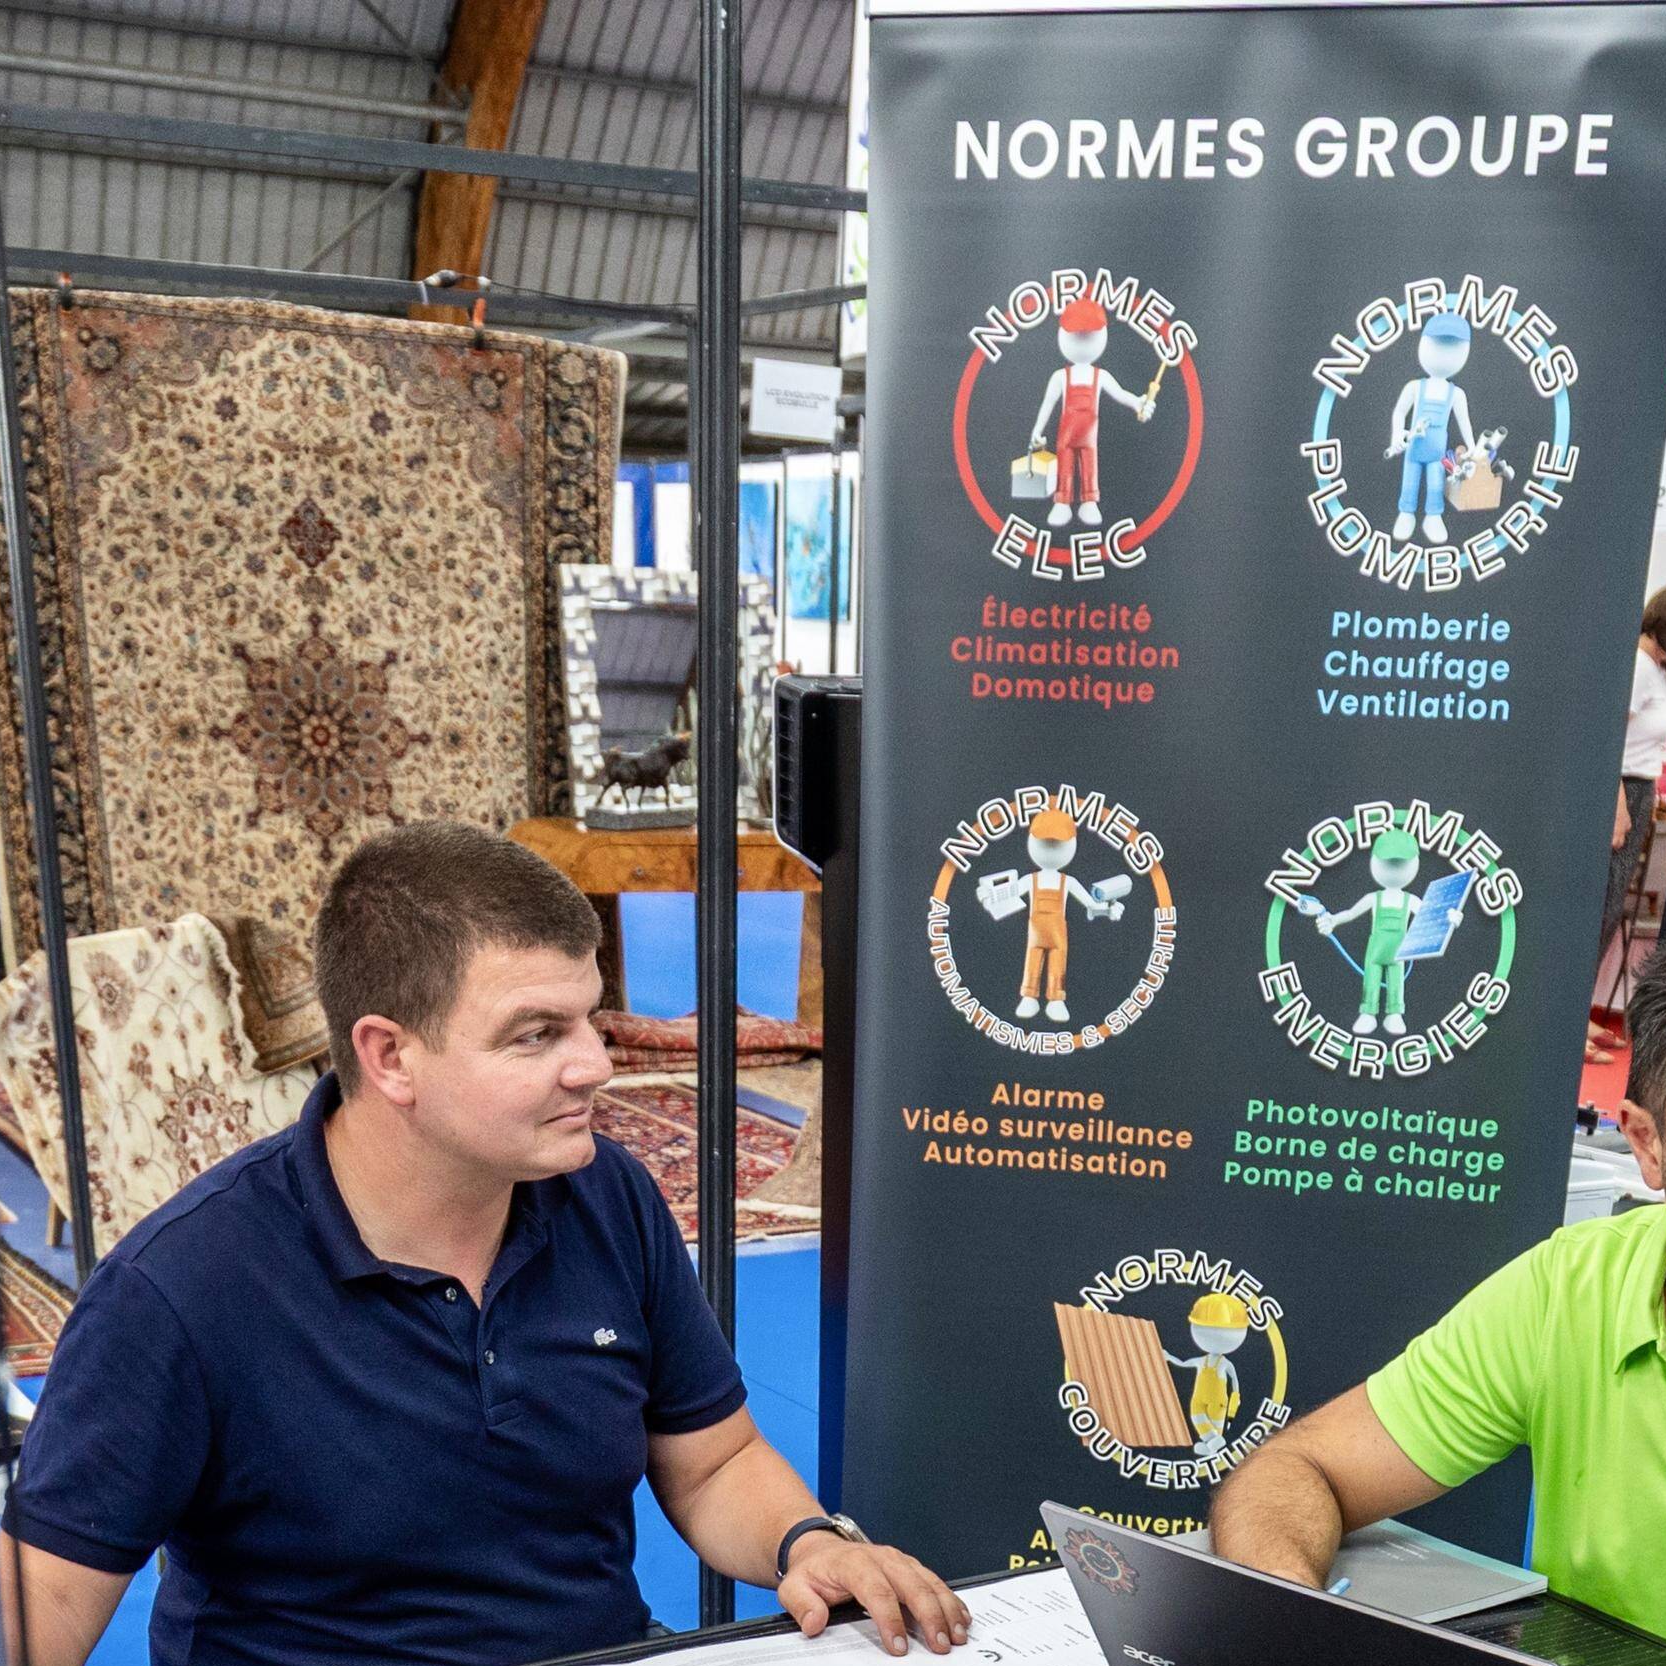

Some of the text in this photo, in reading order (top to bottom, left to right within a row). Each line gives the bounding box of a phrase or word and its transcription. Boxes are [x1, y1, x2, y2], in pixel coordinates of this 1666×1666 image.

[953, 113, 1615, 180] NORMES GROUPE
[968, 267, 1200, 365] NORMES
[1312, 273, 1579, 400] NORMES
[1300, 436, 1581, 593] PLOMBERIE
[991, 514, 1148, 582] ELEC
[980, 595, 1154, 633] Électricité
[1331, 609, 1511, 644] Plomberie
[950, 635, 1181, 670] Climatisation
[1322, 649, 1511, 689] Chauffage
[971, 671, 1156, 710] Domotique
[1317, 687, 1511, 723] Ventilation
[940, 781, 1165, 878] NORMES
[1263, 797, 1522, 918] NORMES
[926, 894, 1178, 1057] AUTOMATISMES & SECURITE
[1257, 959, 1513, 1082] ENERGIES
[990, 1082, 1107, 1114] Alarme
[1245, 1098, 1501, 1142] Photovoltaïque
[901, 1106, 1195, 1152] Vidéo surveillance
[1233, 1129, 1507, 1177] Borne de charge
[922, 1141, 1169, 1180] Automatisation
[1222, 1160, 1502, 1205] Pompe à chaleur
[1079, 1247, 1285, 1335] NORMES
[1057, 1380, 1293, 1492] COUVERTURE
